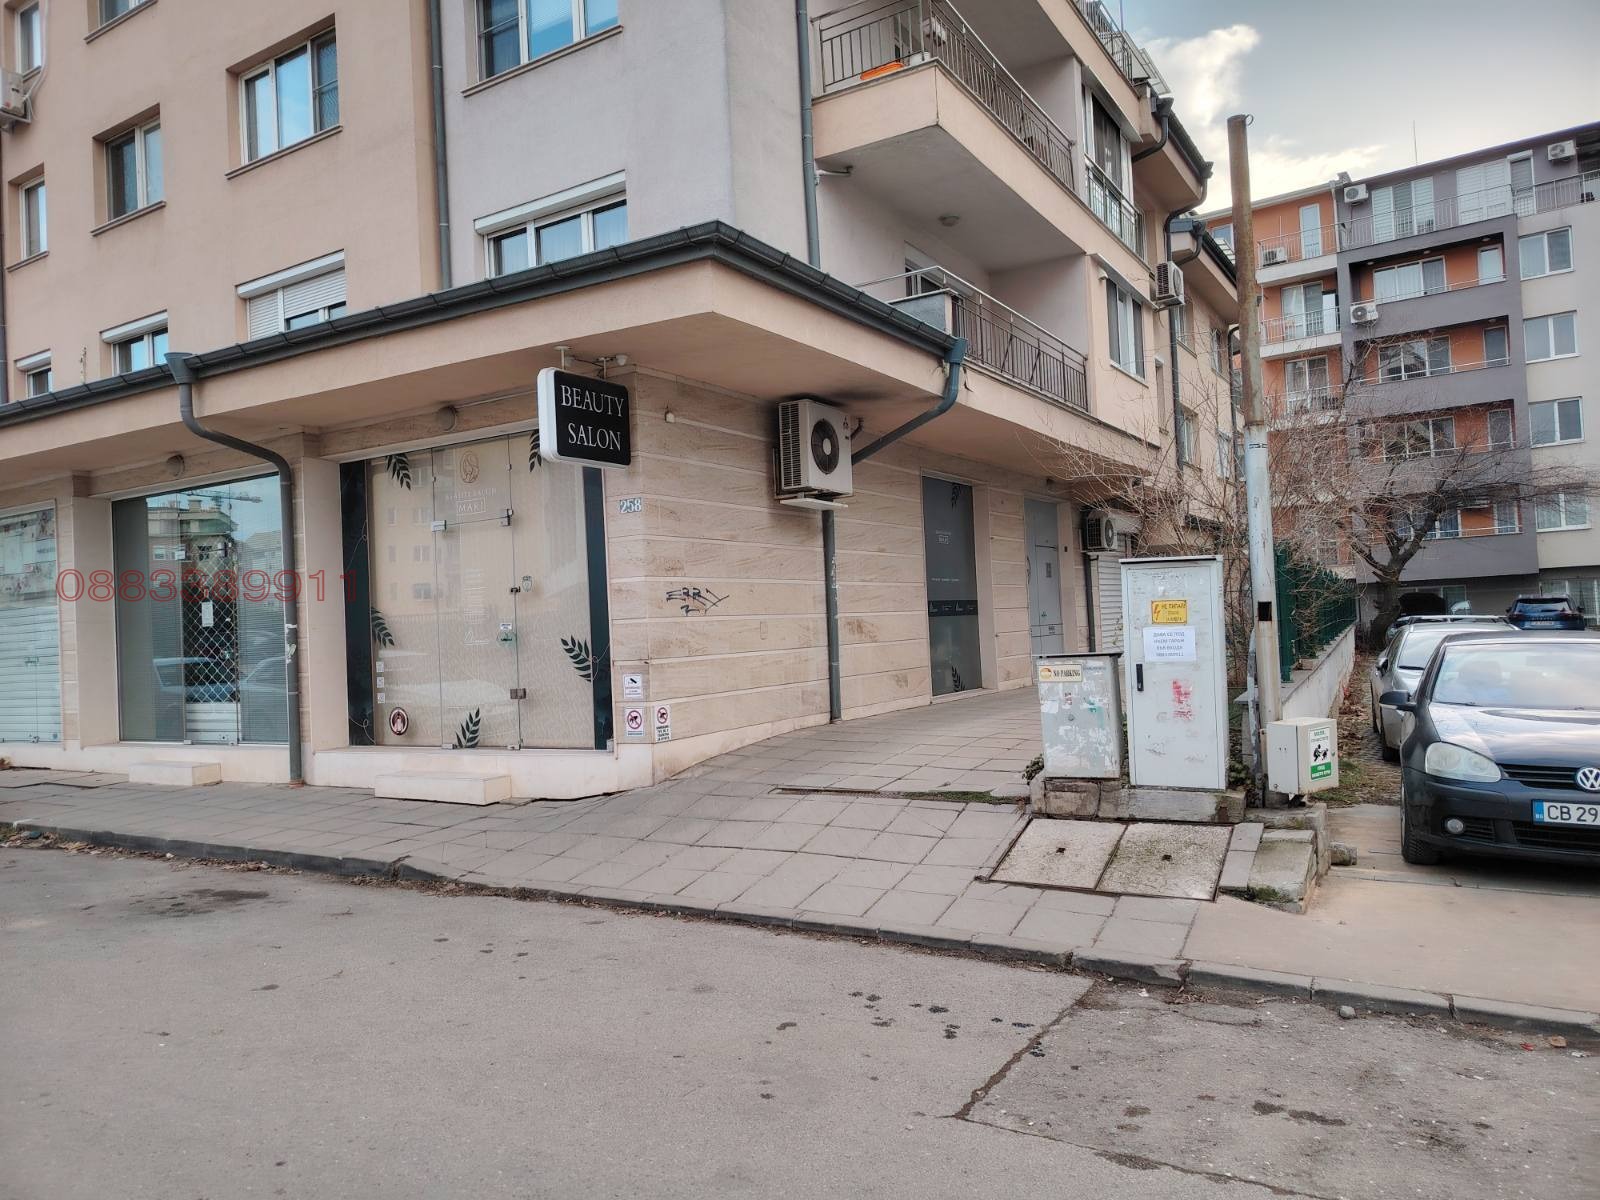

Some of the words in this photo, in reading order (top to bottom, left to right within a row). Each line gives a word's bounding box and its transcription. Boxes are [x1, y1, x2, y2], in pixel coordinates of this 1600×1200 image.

[560, 384, 624, 417] BEAUTY
[567, 422, 621, 452] SALON
[620, 498, 641, 513] 258
[1547, 805, 1571, 821] CB
